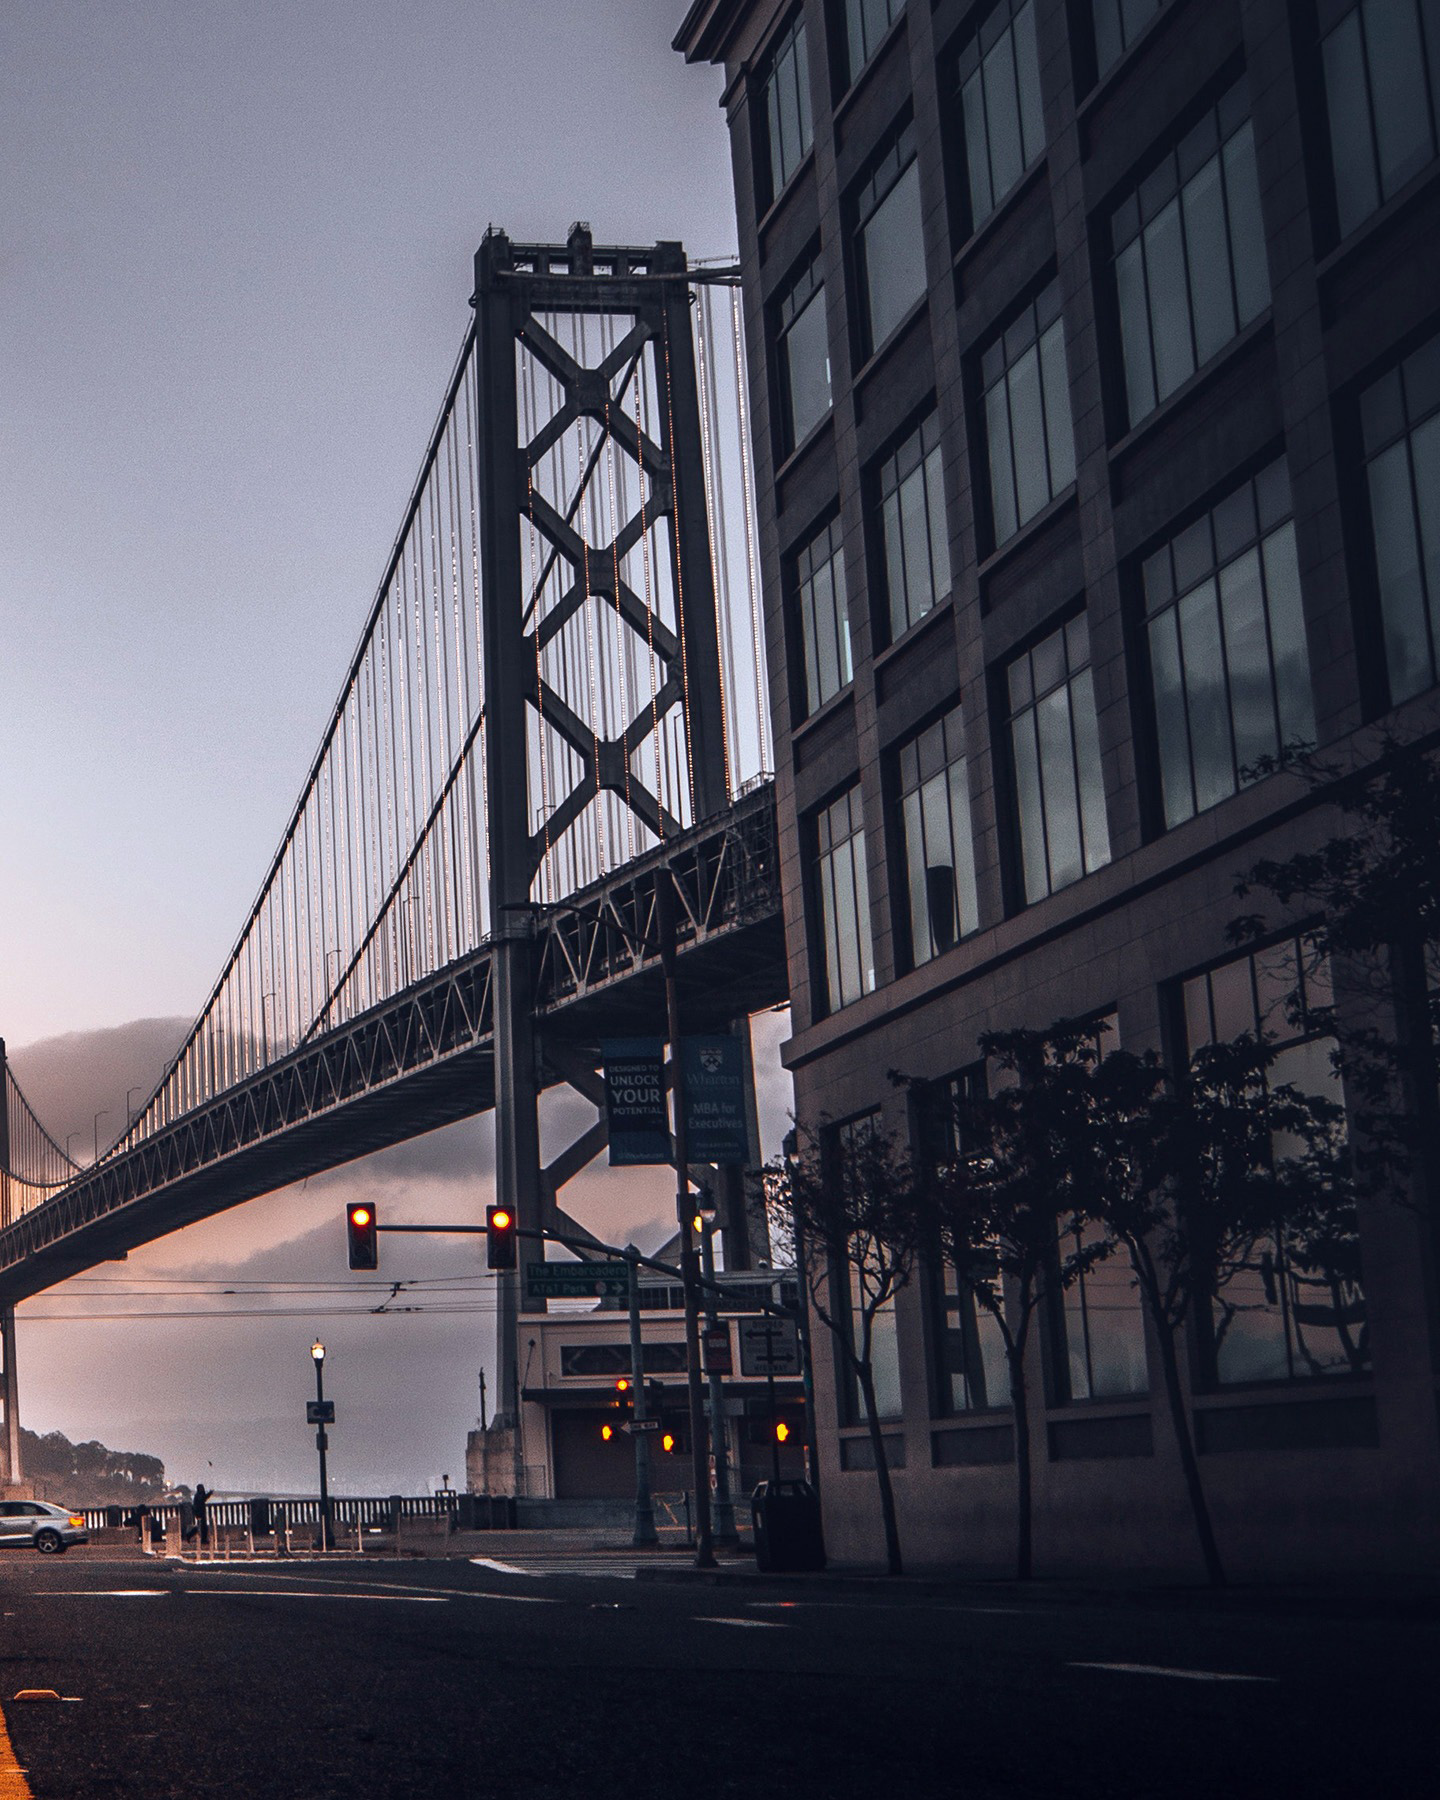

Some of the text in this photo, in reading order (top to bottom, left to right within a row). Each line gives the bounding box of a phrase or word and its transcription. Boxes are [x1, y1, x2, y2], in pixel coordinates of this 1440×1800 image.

[609, 1064, 659, 1073] DESIGNED TO
[610, 1075, 659, 1086] UNLOCK
[687, 1073, 740, 1085] Wharton
[612, 1089, 660, 1103] YOUR
[613, 1107, 663, 1115] POTENTIAL
[693, 1102, 736, 1114] MBA for
[688, 1117, 743, 1129] Executives
[529, 1265, 627, 1276] The Embarcadero
[563, 1283, 587, 1294] Park
